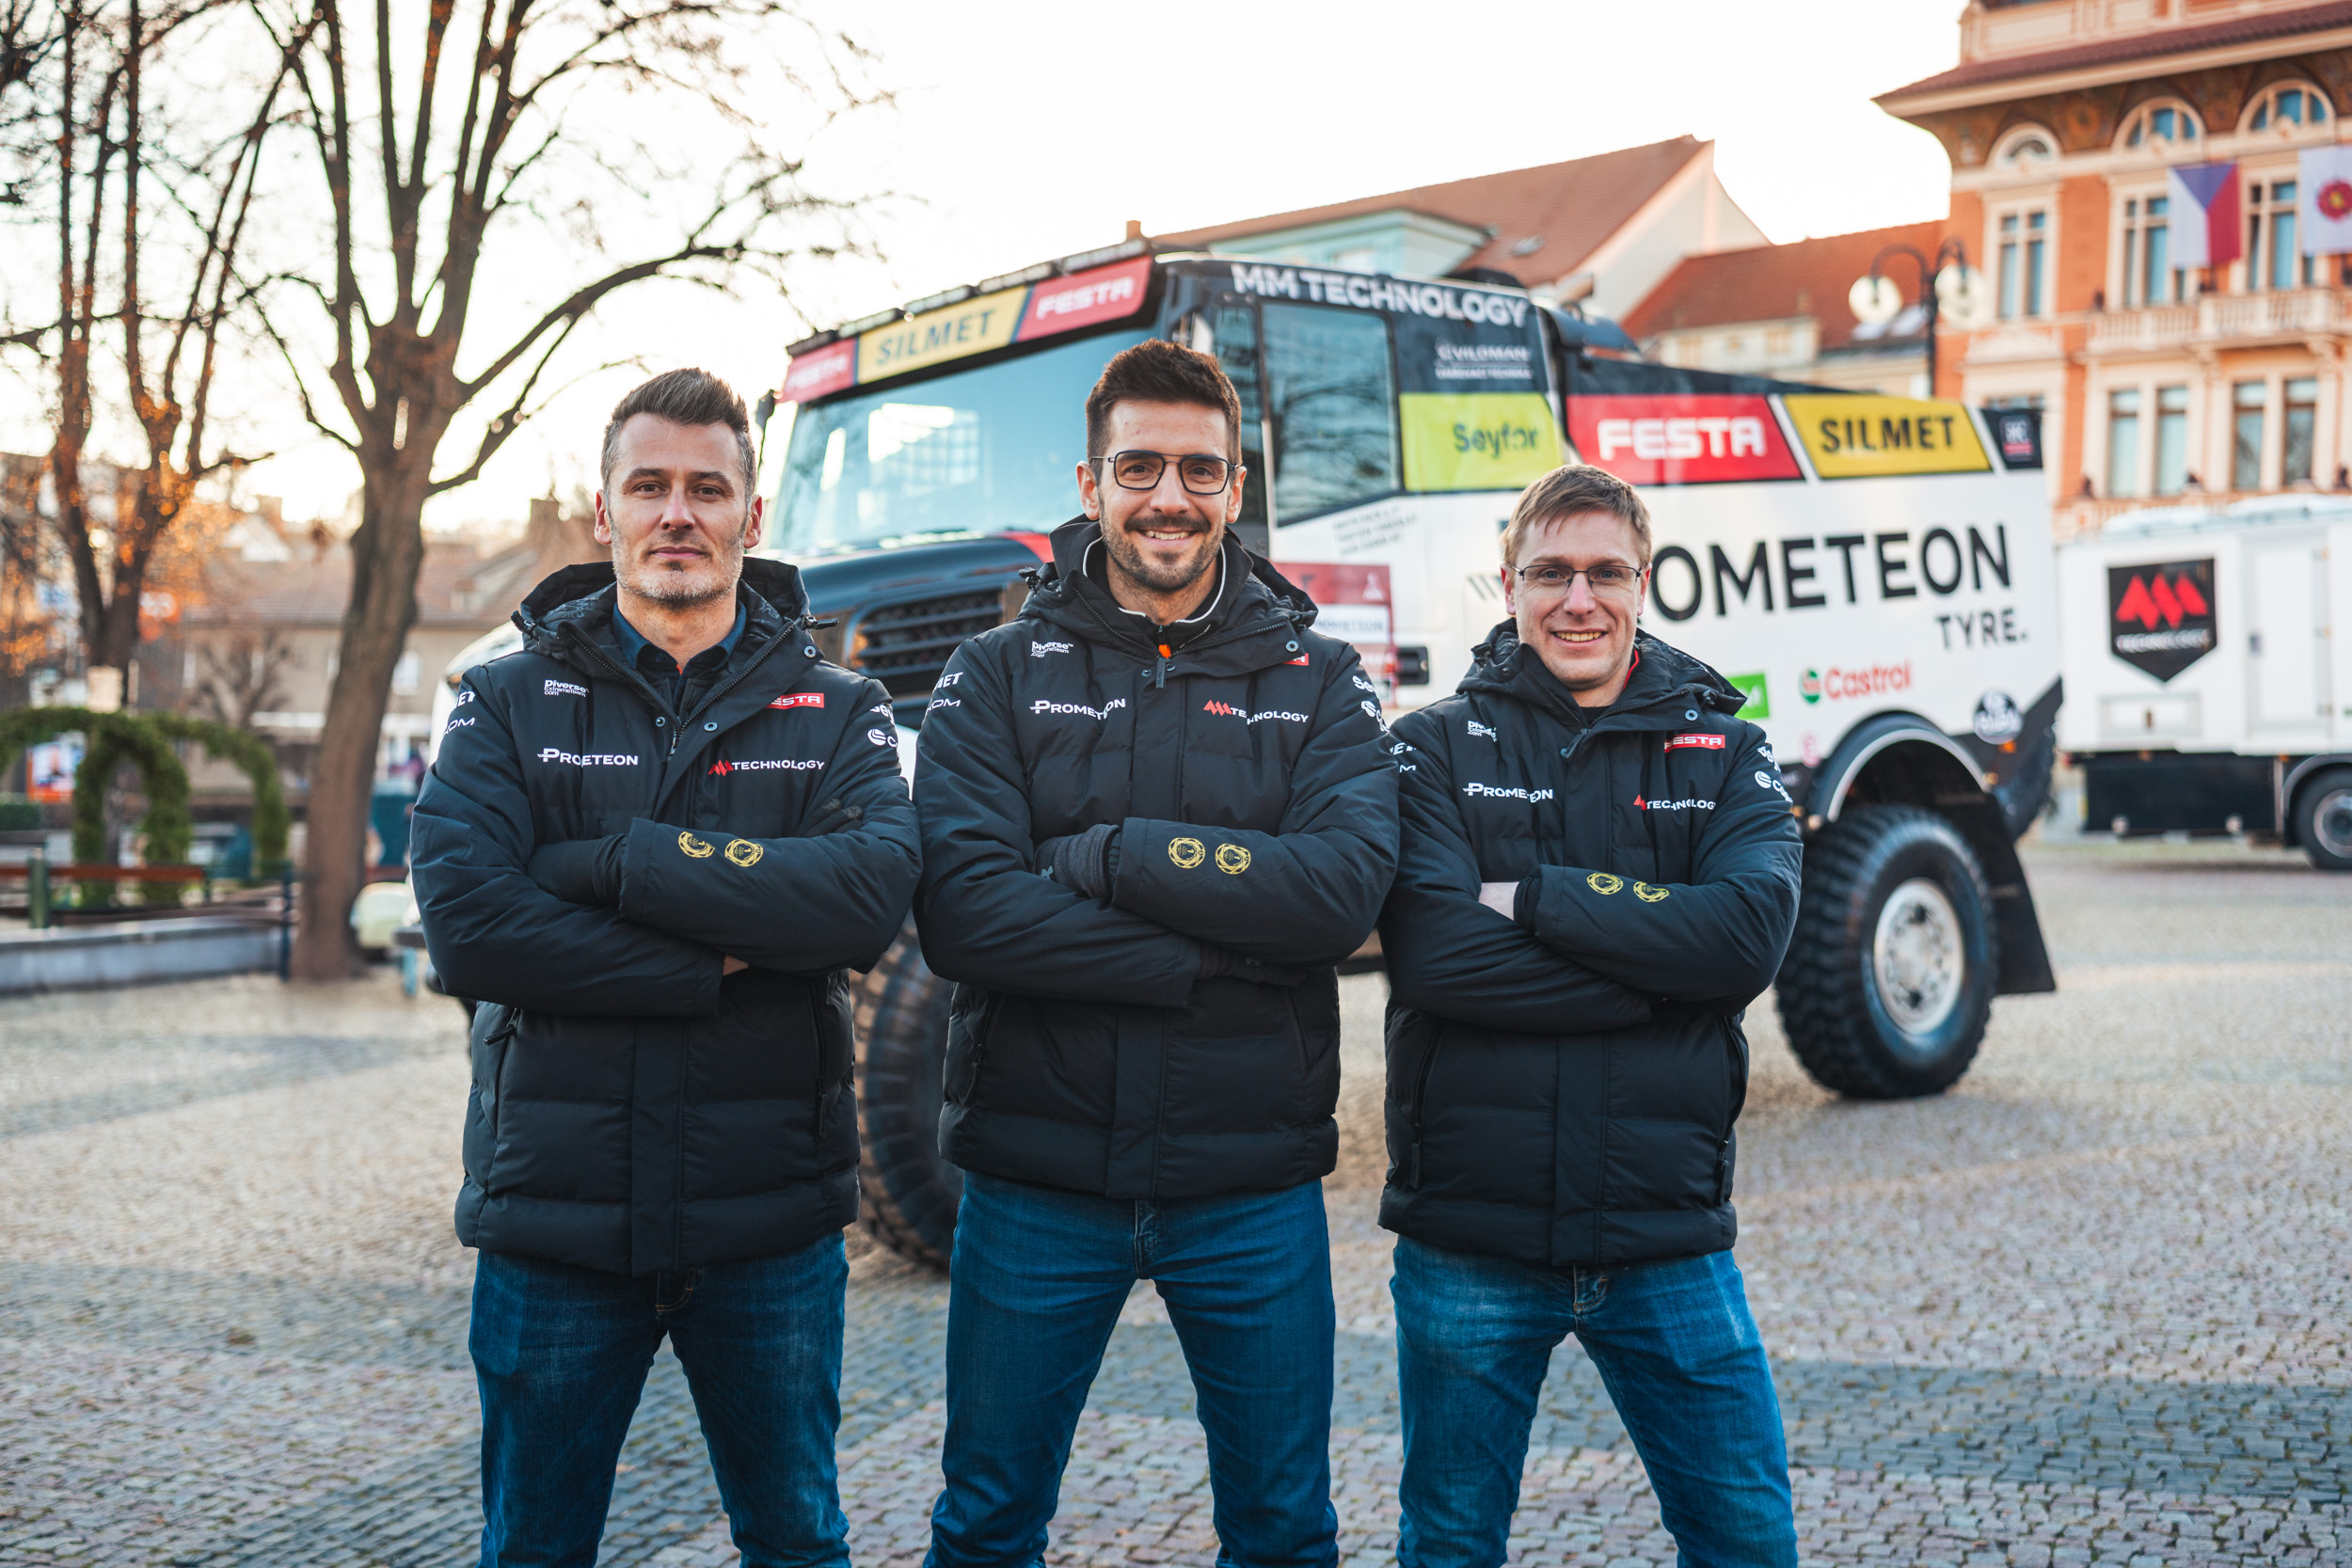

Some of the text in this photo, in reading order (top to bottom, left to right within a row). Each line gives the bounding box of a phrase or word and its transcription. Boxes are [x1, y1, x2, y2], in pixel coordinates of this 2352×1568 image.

[1037, 277, 1135, 320] FESTA
[1231, 263, 1529, 328] MM TECHNOLOGY
[876, 309, 995, 366] SILMET
[1454, 422, 1538, 459] Seyfor
[1597, 417, 1767, 462] FESTA
[1820, 415, 1955, 455] SILMET
[1649, 523, 2012, 621] OMETEON
[1032, 641, 1069, 650] Diverse
[545, 679, 587, 693] Diverse
[1824, 662, 1912, 700] Castrol
[771, 695, 820, 706] ESTA
[1231, 706, 1309, 724] TEHNOLOGY
[537, 748, 639, 768] PROETEON
[731, 759, 825, 771] TECHNOLOGY
[1463, 783, 1553, 803] PROMEEON
